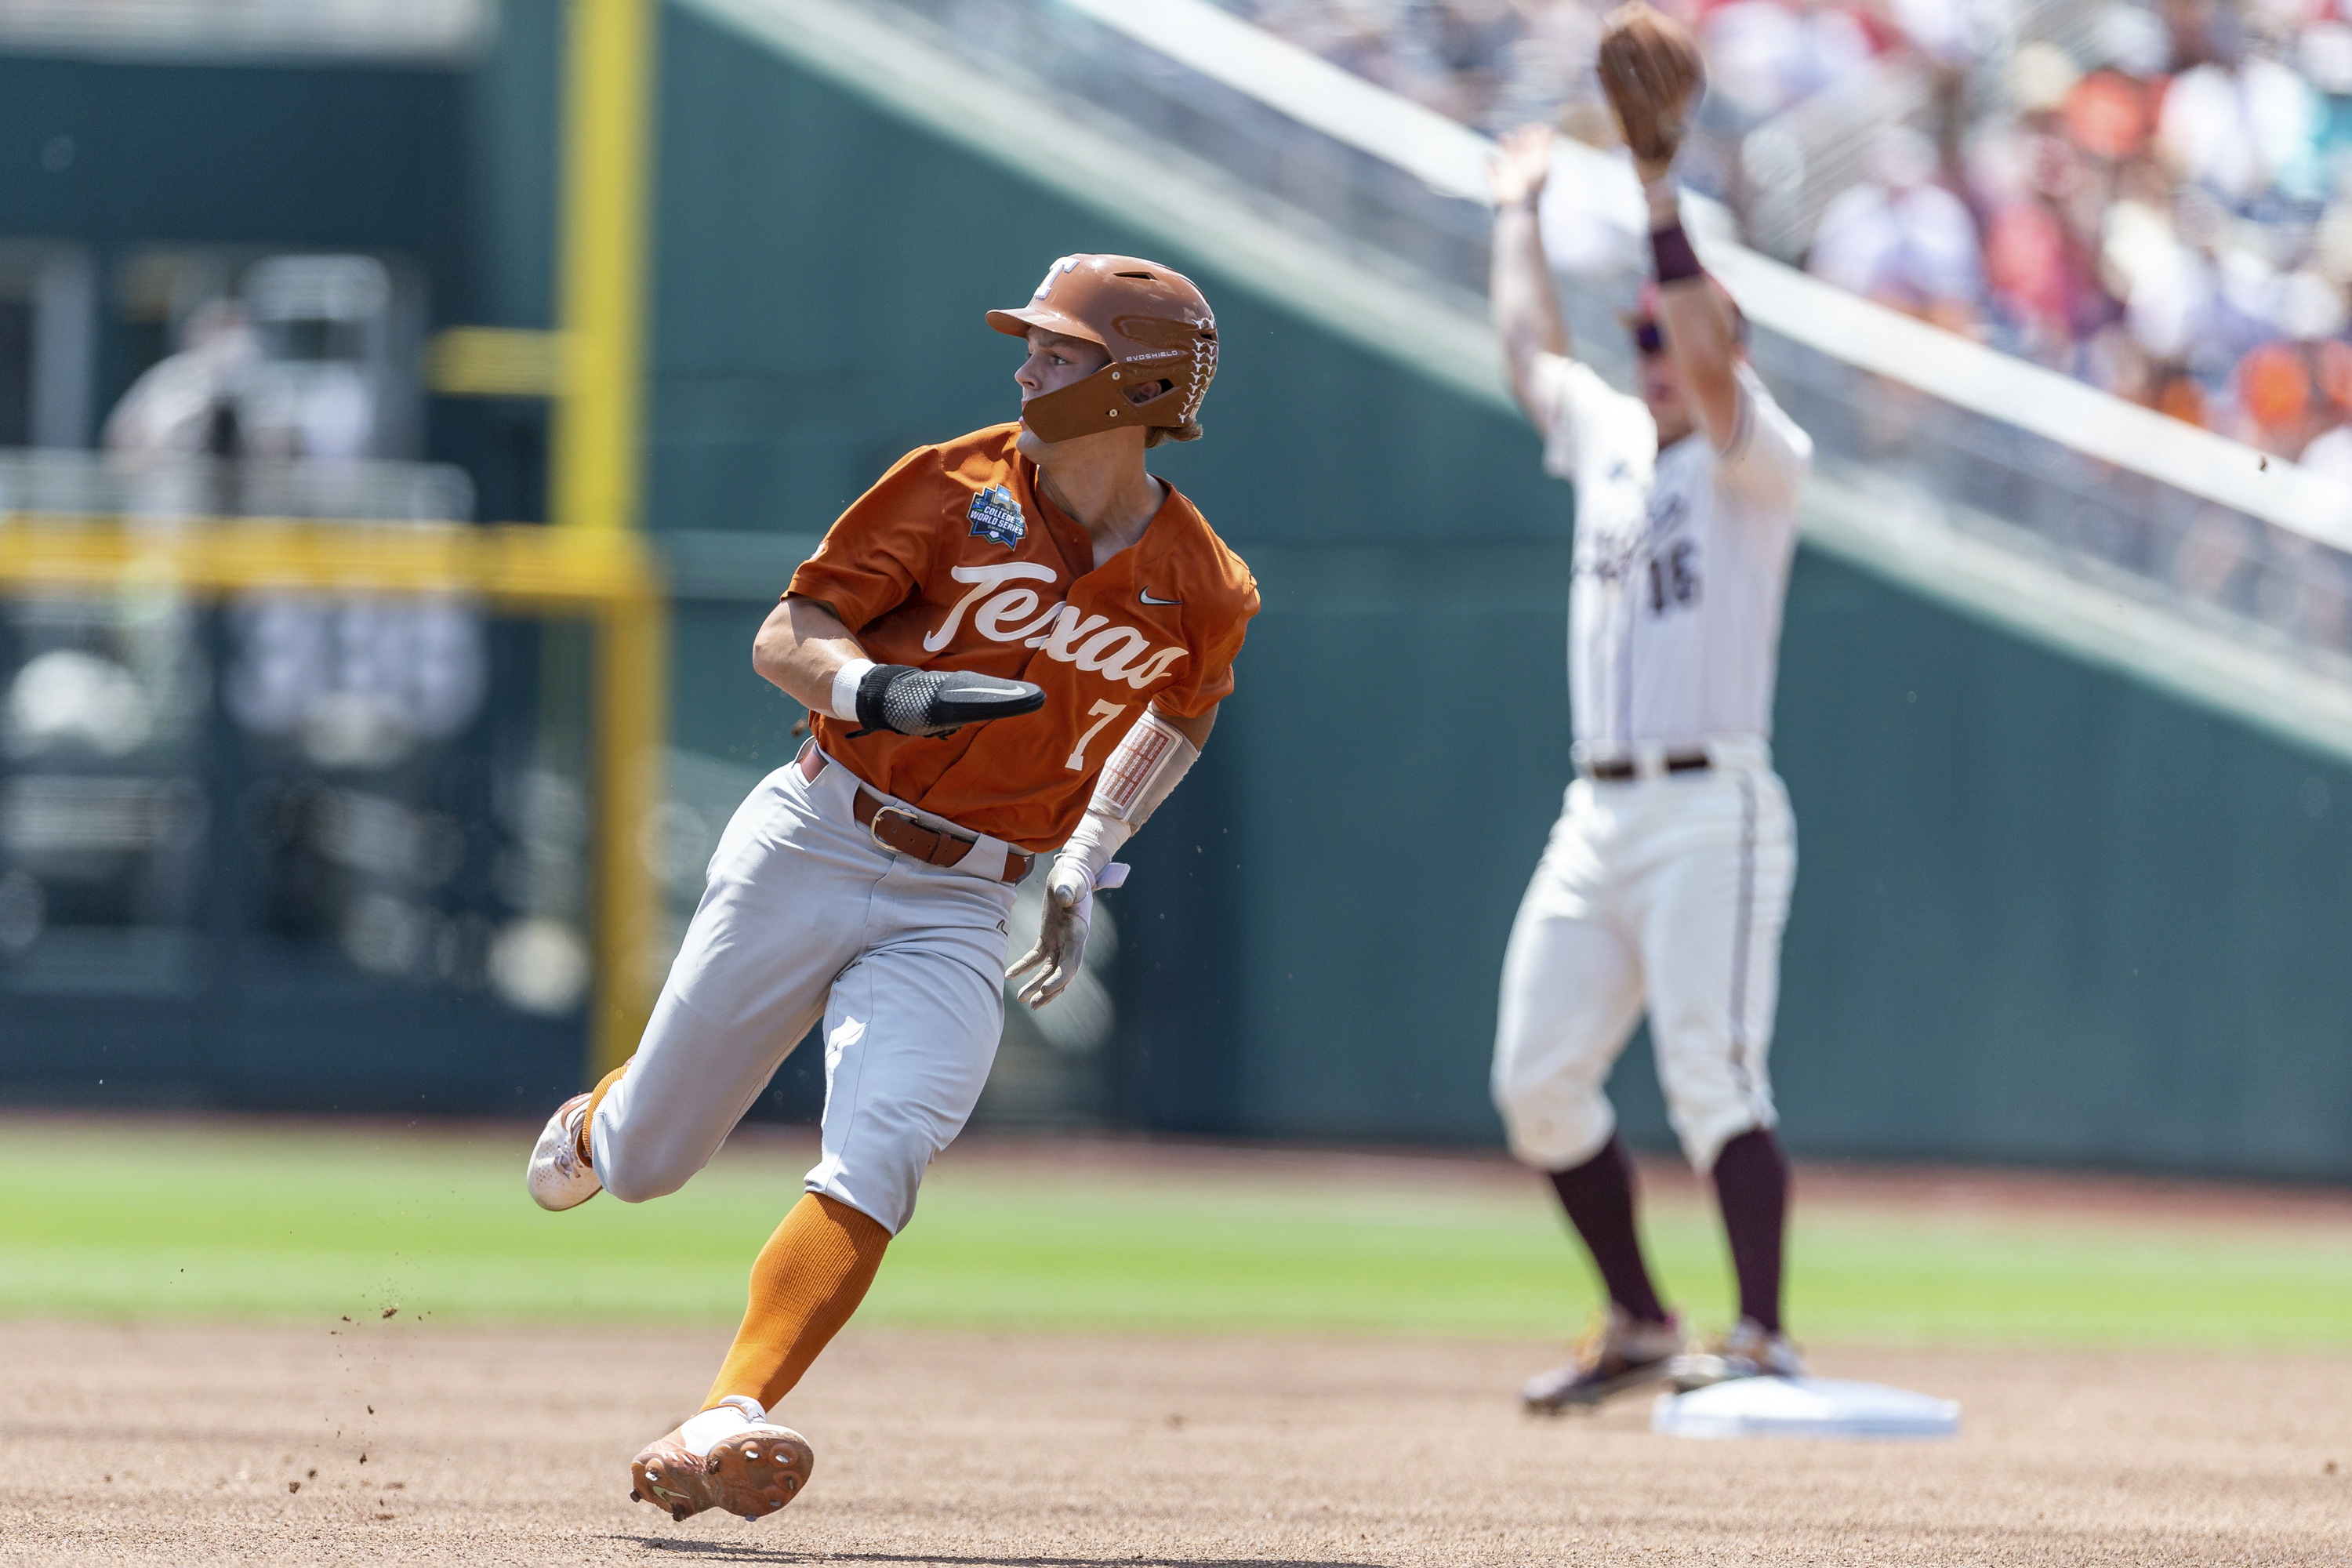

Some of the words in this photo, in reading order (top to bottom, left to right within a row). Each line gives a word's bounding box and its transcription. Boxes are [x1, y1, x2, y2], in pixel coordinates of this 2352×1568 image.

[1033, 256, 1080, 300] T
[1126, 350, 1178, 362] EVOSHIELD
[970, 510, 997, 524] WORLD
[998, 520, 1024, 535] SERIES
[984, 506, 1015, 523] COLLEGE
[923, 561, 1189, 690] Texas
[1065, 698, 1127, 771] 7
